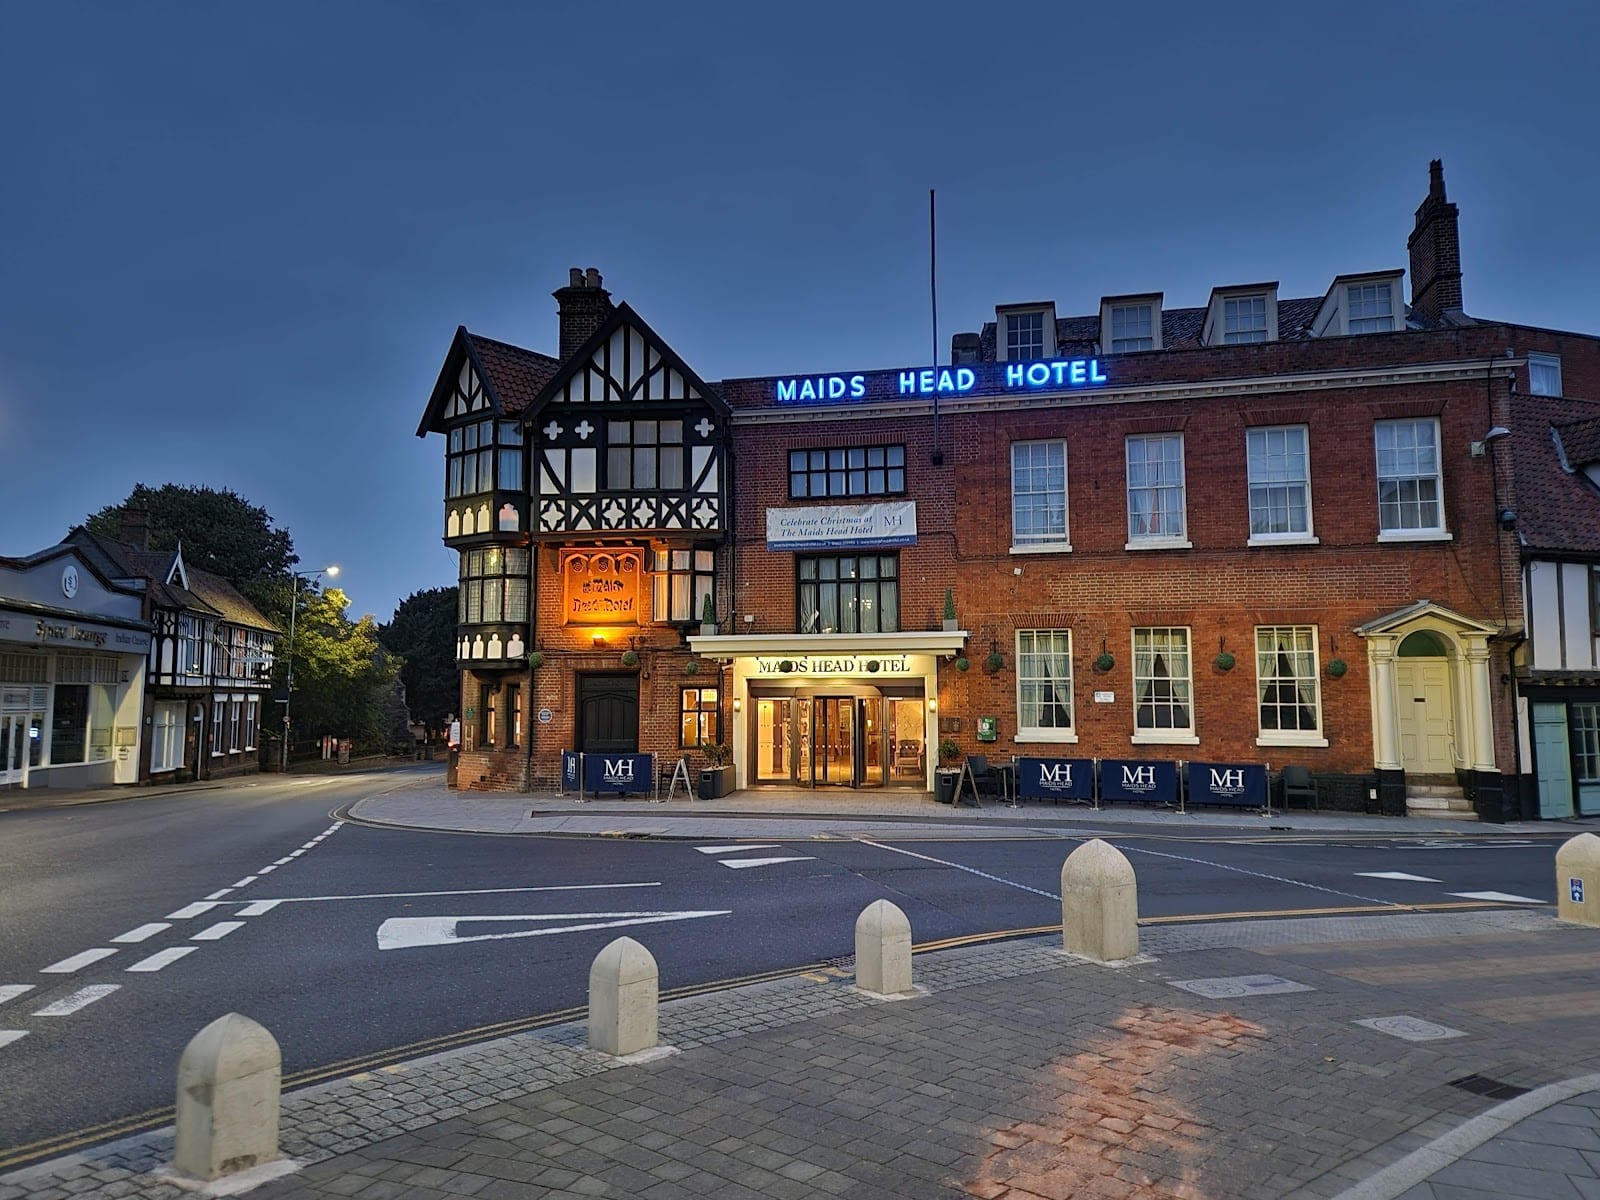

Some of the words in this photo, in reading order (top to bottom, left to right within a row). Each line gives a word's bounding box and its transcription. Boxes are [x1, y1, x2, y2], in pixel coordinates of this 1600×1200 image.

[777, 375, 866, 401] MAIDS
[899, 368, 975, 394] HEAD
[1007, 359, 1106, 387] HOTEL
[780, 517, 818, 527] Celebrate
[821, 516, 861, 525] Christmas
[781, 527, 796, 537] The
[798, 527, 823, 537] Maids
[826, 526, 848, 536] Head
[850, 526, 873, 535] Hotel
[759, 660, 808, 673] MADS
[812, 660, 854, 672] HEAD
[859, 660, 910, 672] HTEL
[603, 759, 635, 776] MH
[1040, 763, 1072, 781] MH
[1121, 765, 1155, 784] MH
[1209, 768, 1245, 787] MH
